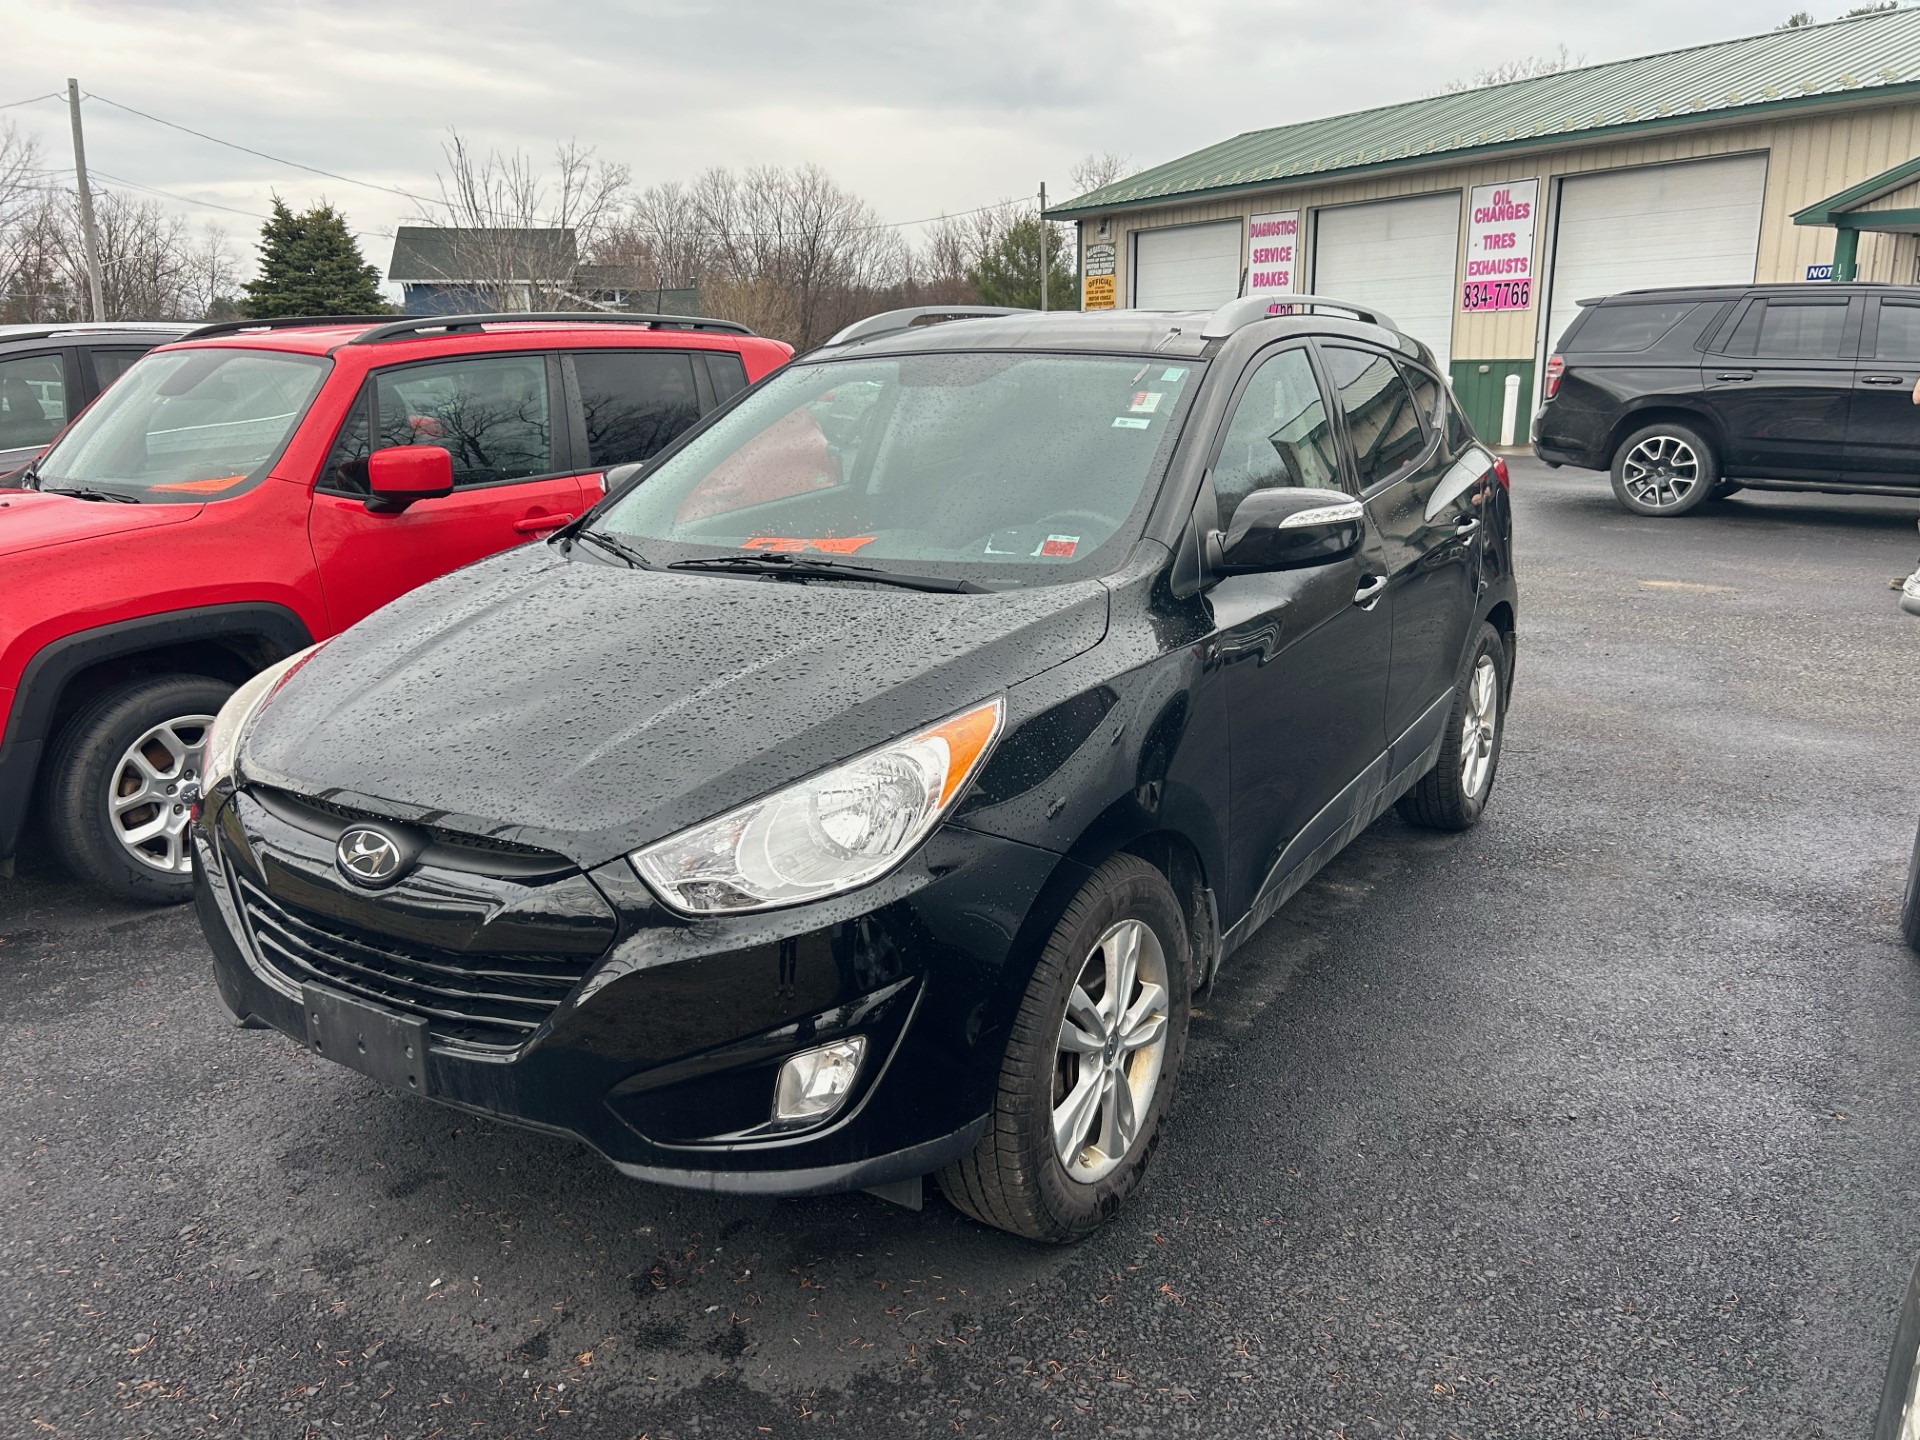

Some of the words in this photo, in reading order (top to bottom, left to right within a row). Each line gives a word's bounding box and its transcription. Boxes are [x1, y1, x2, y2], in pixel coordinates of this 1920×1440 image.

[1493, 189, 1512, 206] OIL
[1474, 202, 1530, 224] CHANGES
[1250, 220, 1297, 238] DIAGNOSTICS
[1483, 232, 1516, 250] TIRES
[1253, 246, 1292, 264] SERVICE
[1468, 257, 1529, 277] EXHAUSTS
[1088, 278, 1112, 288] OFFICIAL
[1253, 270, 1289, 288] BRAKES
[1463, 281, 1530, 308] 834-7766
